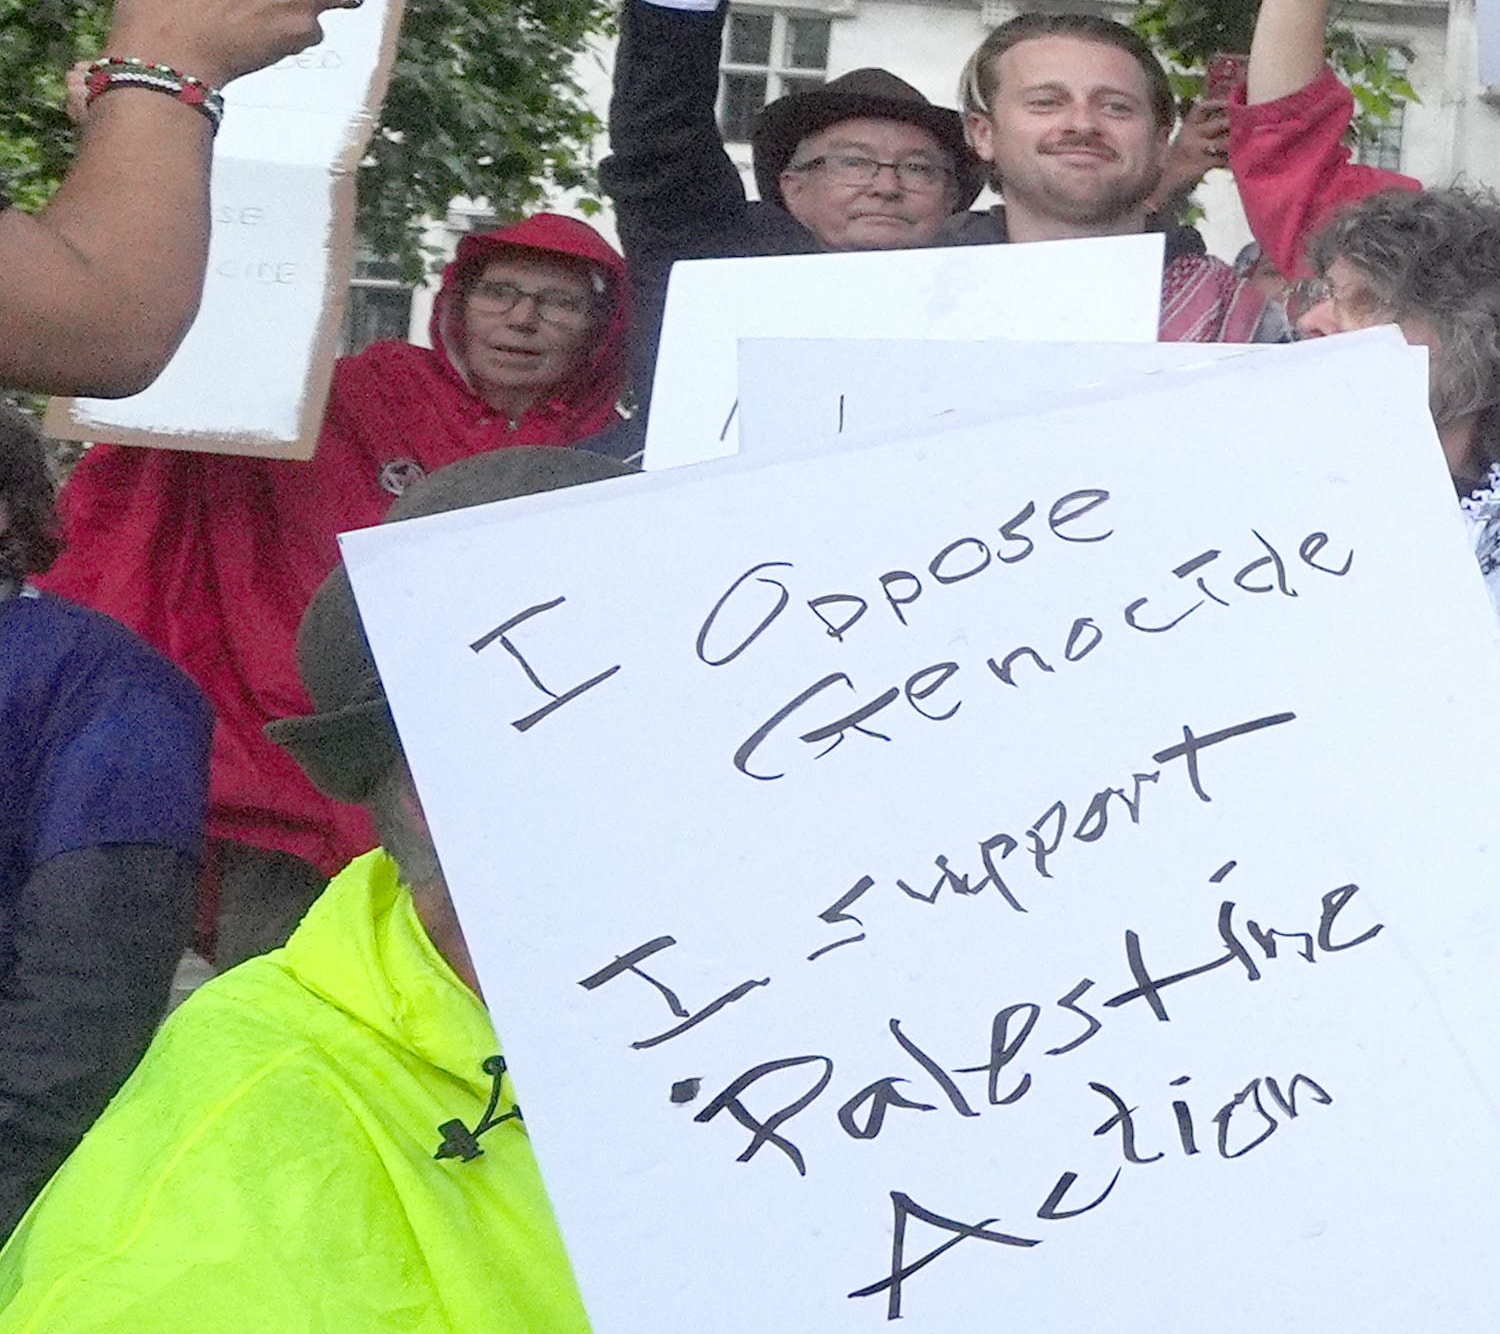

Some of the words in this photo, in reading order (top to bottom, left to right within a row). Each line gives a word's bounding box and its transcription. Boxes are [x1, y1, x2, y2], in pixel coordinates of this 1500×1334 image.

[468, 596, 620, 732] I
[734, 529, 1353, 782] Genocide
[579, 935, 772, 1050] I
[807, 713, 1297, 964] support
[692, 860, 1385, 1176] Palestine
[847, 1070, 1338, 1322] Action
